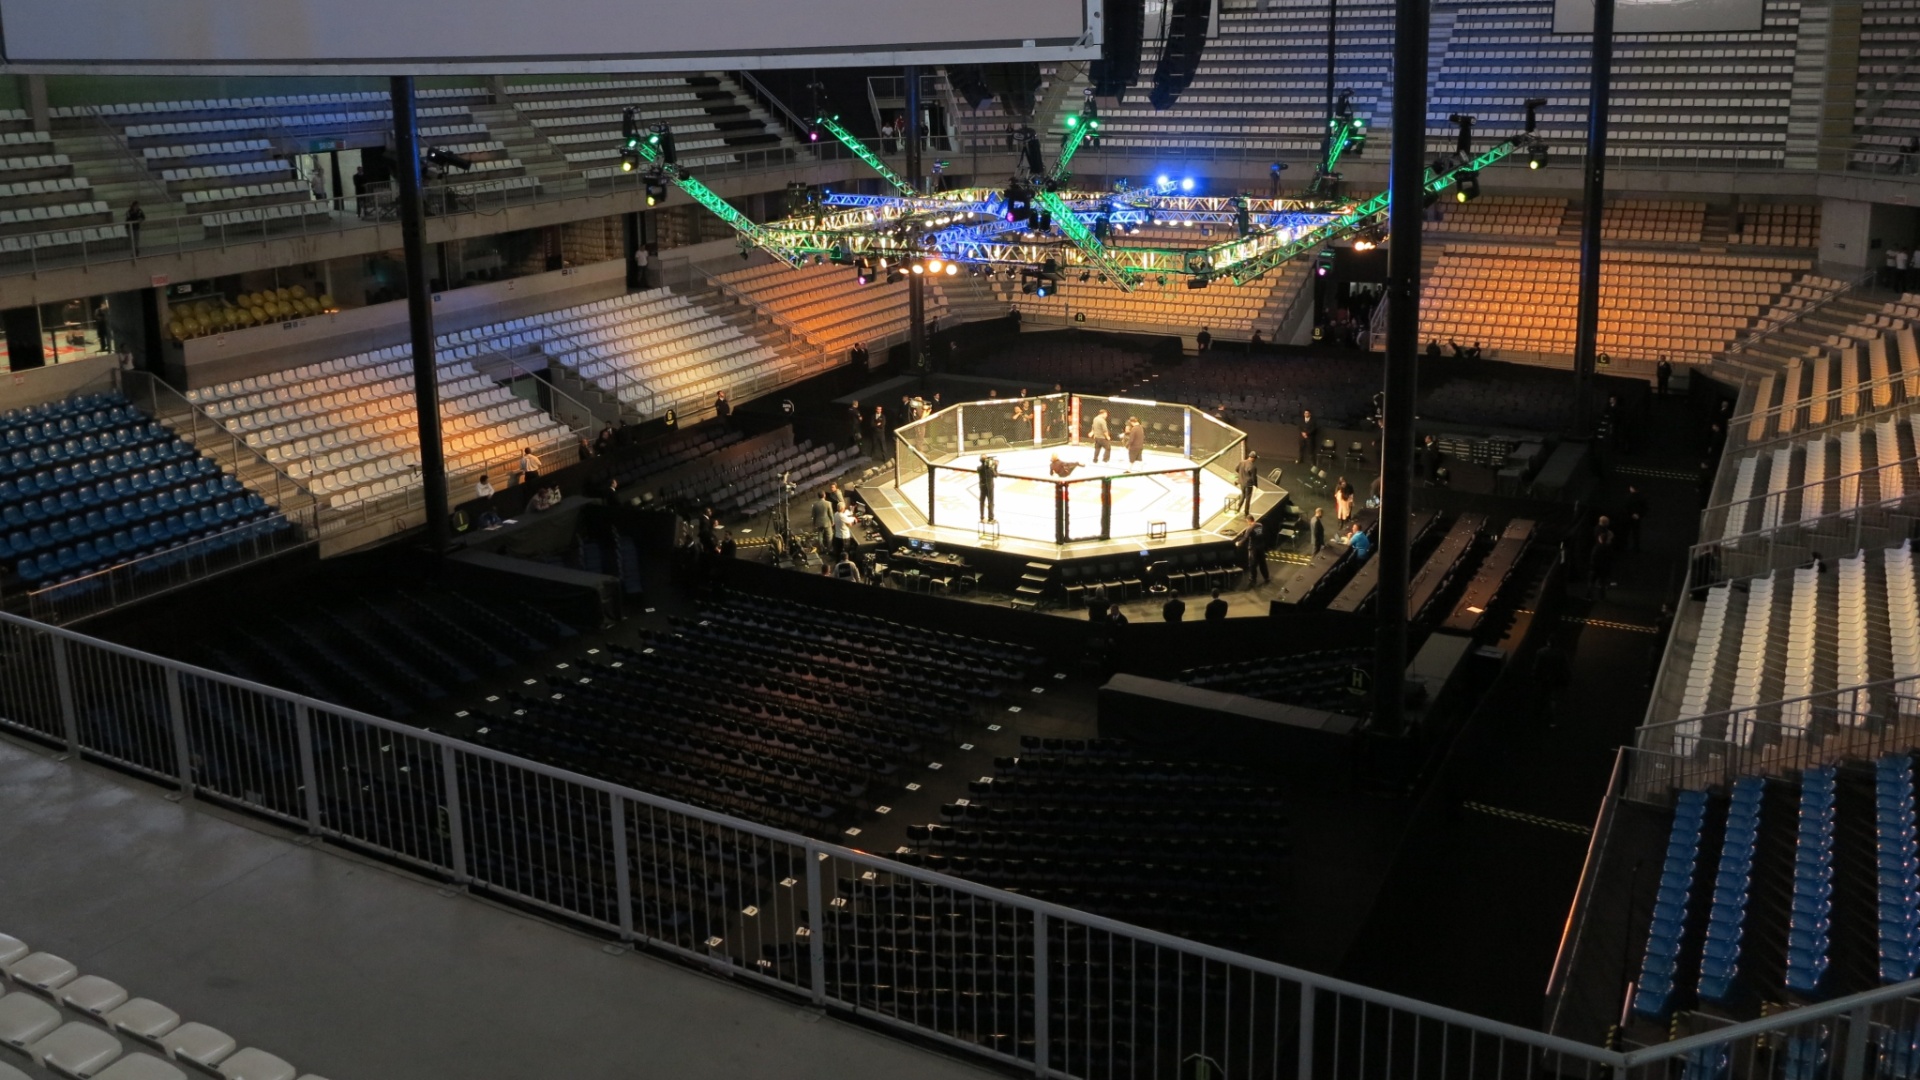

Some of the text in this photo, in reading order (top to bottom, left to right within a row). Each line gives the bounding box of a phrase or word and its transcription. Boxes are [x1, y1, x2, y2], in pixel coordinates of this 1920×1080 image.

[1077, 313, 1083, 321] A
[1314, 327, 1320, 336] B
[1600, 354, 1606, 363] C
[1351, 671, 1363, 688] H
